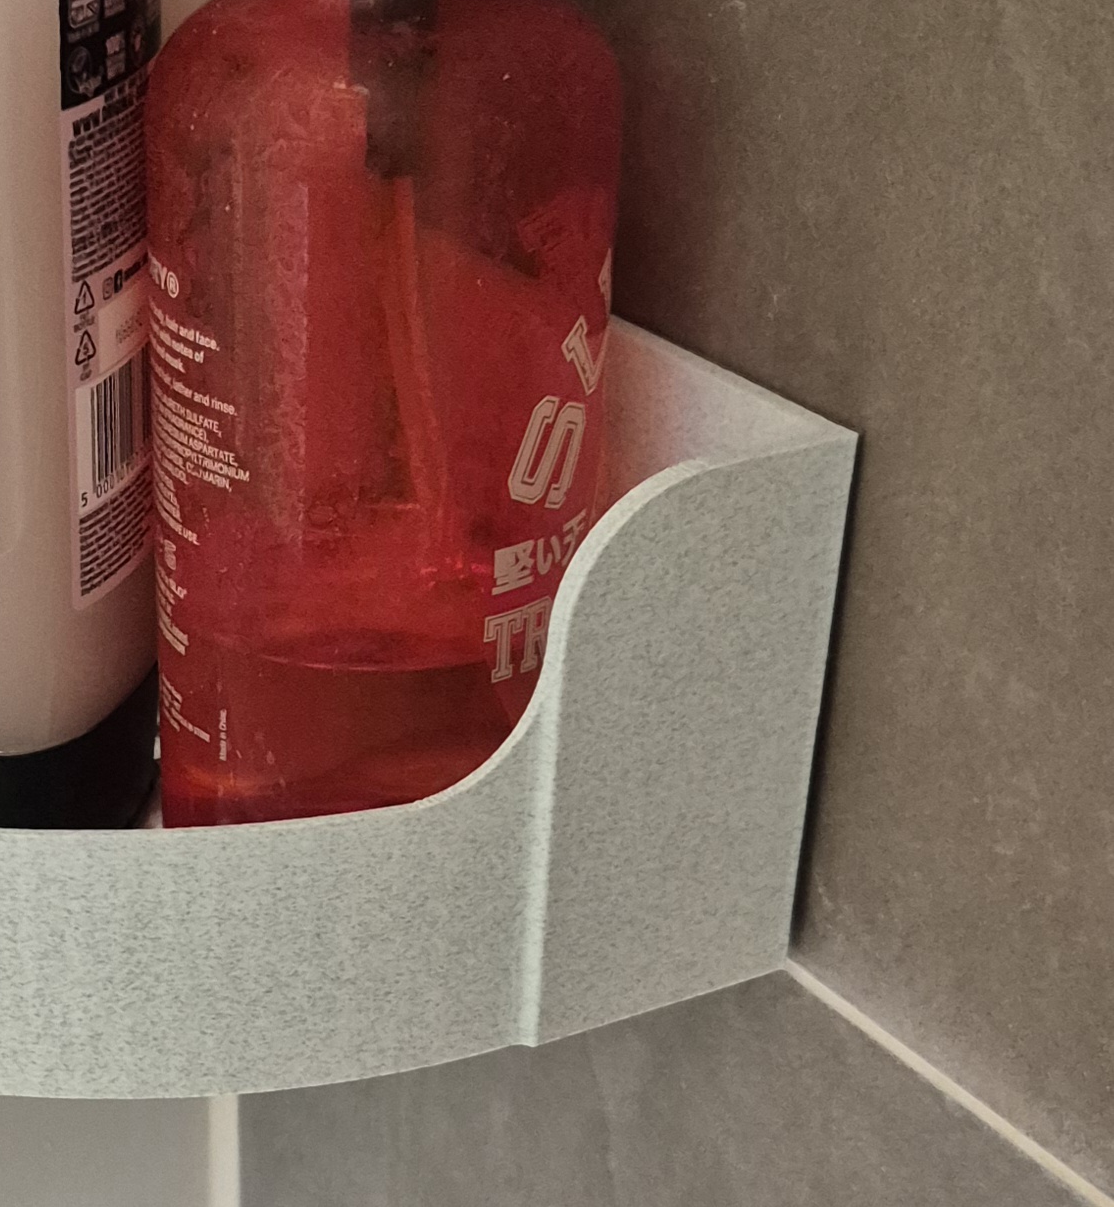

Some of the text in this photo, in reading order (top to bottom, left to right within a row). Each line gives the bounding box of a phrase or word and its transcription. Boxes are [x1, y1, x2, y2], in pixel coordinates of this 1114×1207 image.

[194, 350, 204, 364] of
[193, 392, 210, 407] and
[211, 396, 238, 417] rinse.
